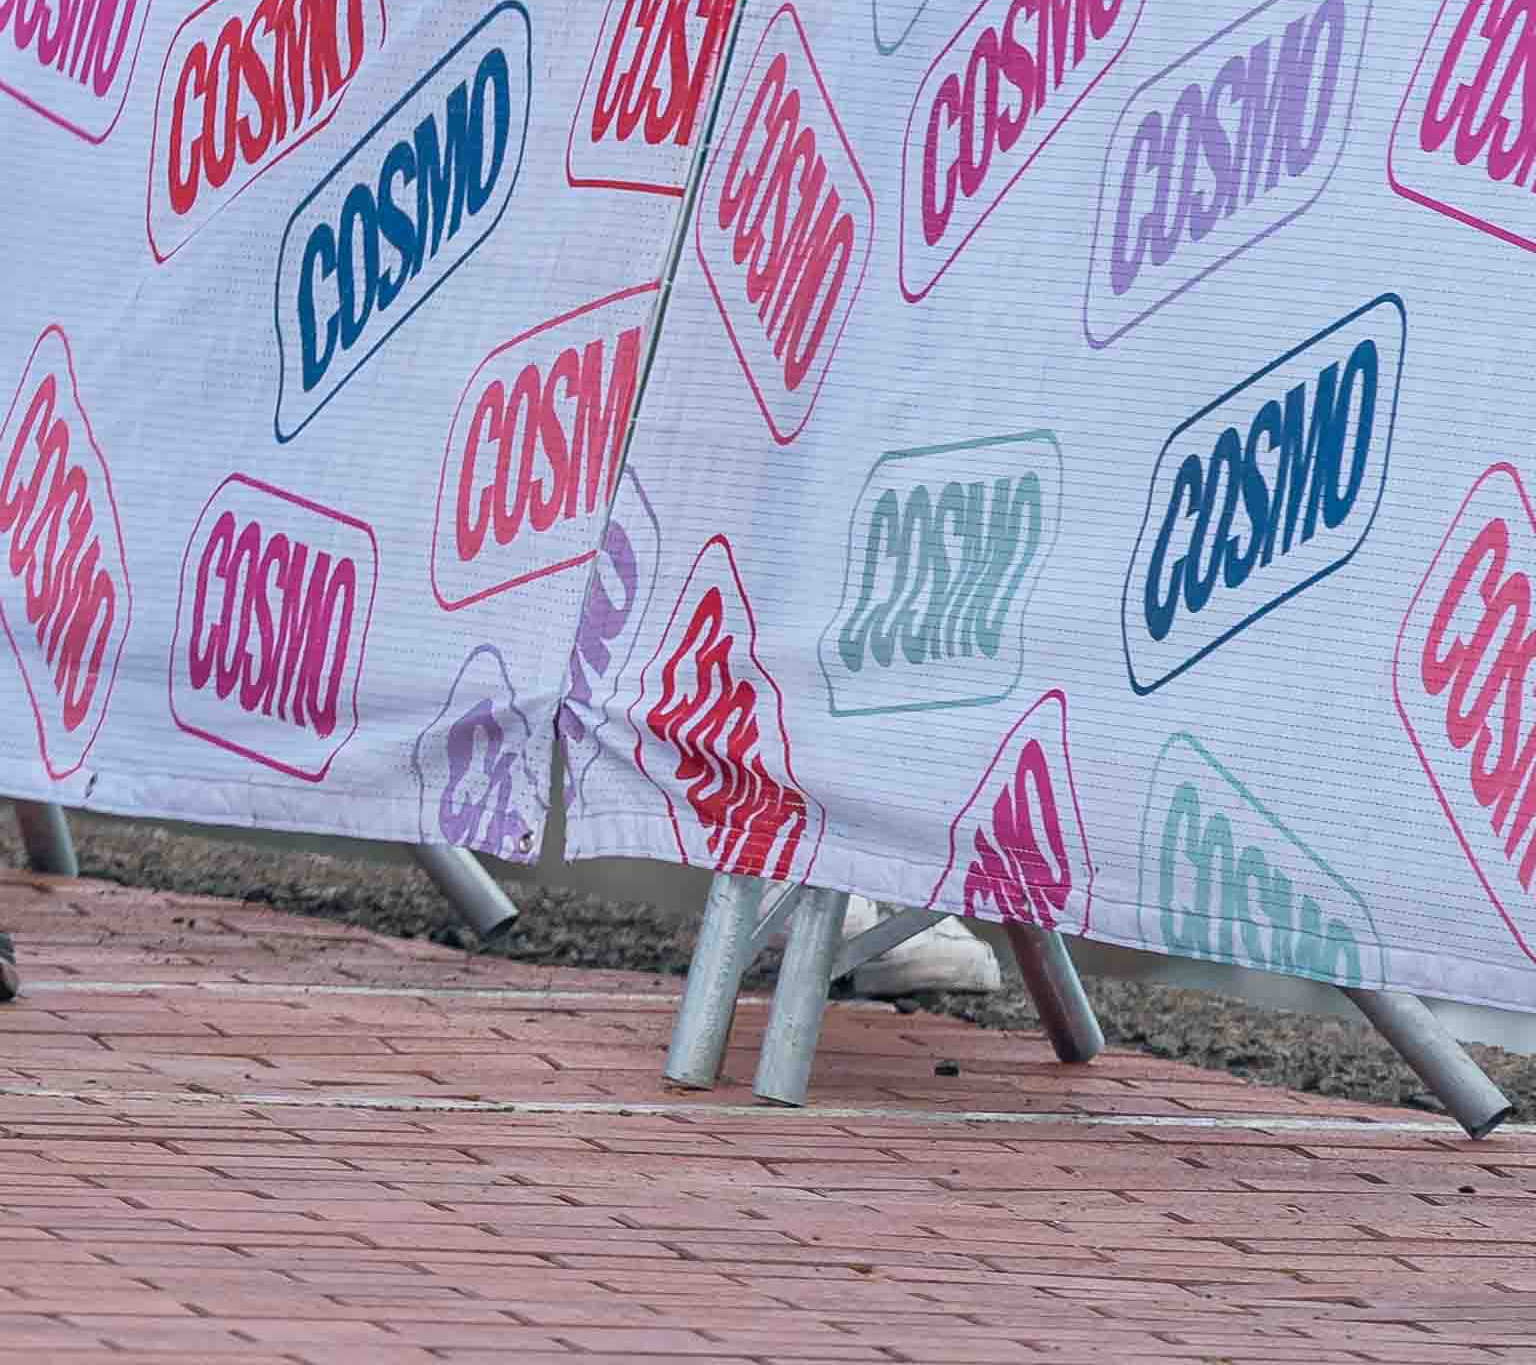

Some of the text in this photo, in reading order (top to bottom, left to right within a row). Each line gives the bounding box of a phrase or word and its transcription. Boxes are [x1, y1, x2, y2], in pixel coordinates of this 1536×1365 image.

[298, 47, 511, 392] COSMO
[719, 52, 854, 392] COSMO
[457, 326, 641, 562] COSM
[838, 469, 1042, 672] COSMO
[1144, 337, 1380, 642] COSMO
[189, 510, 356, 739] COSMO
